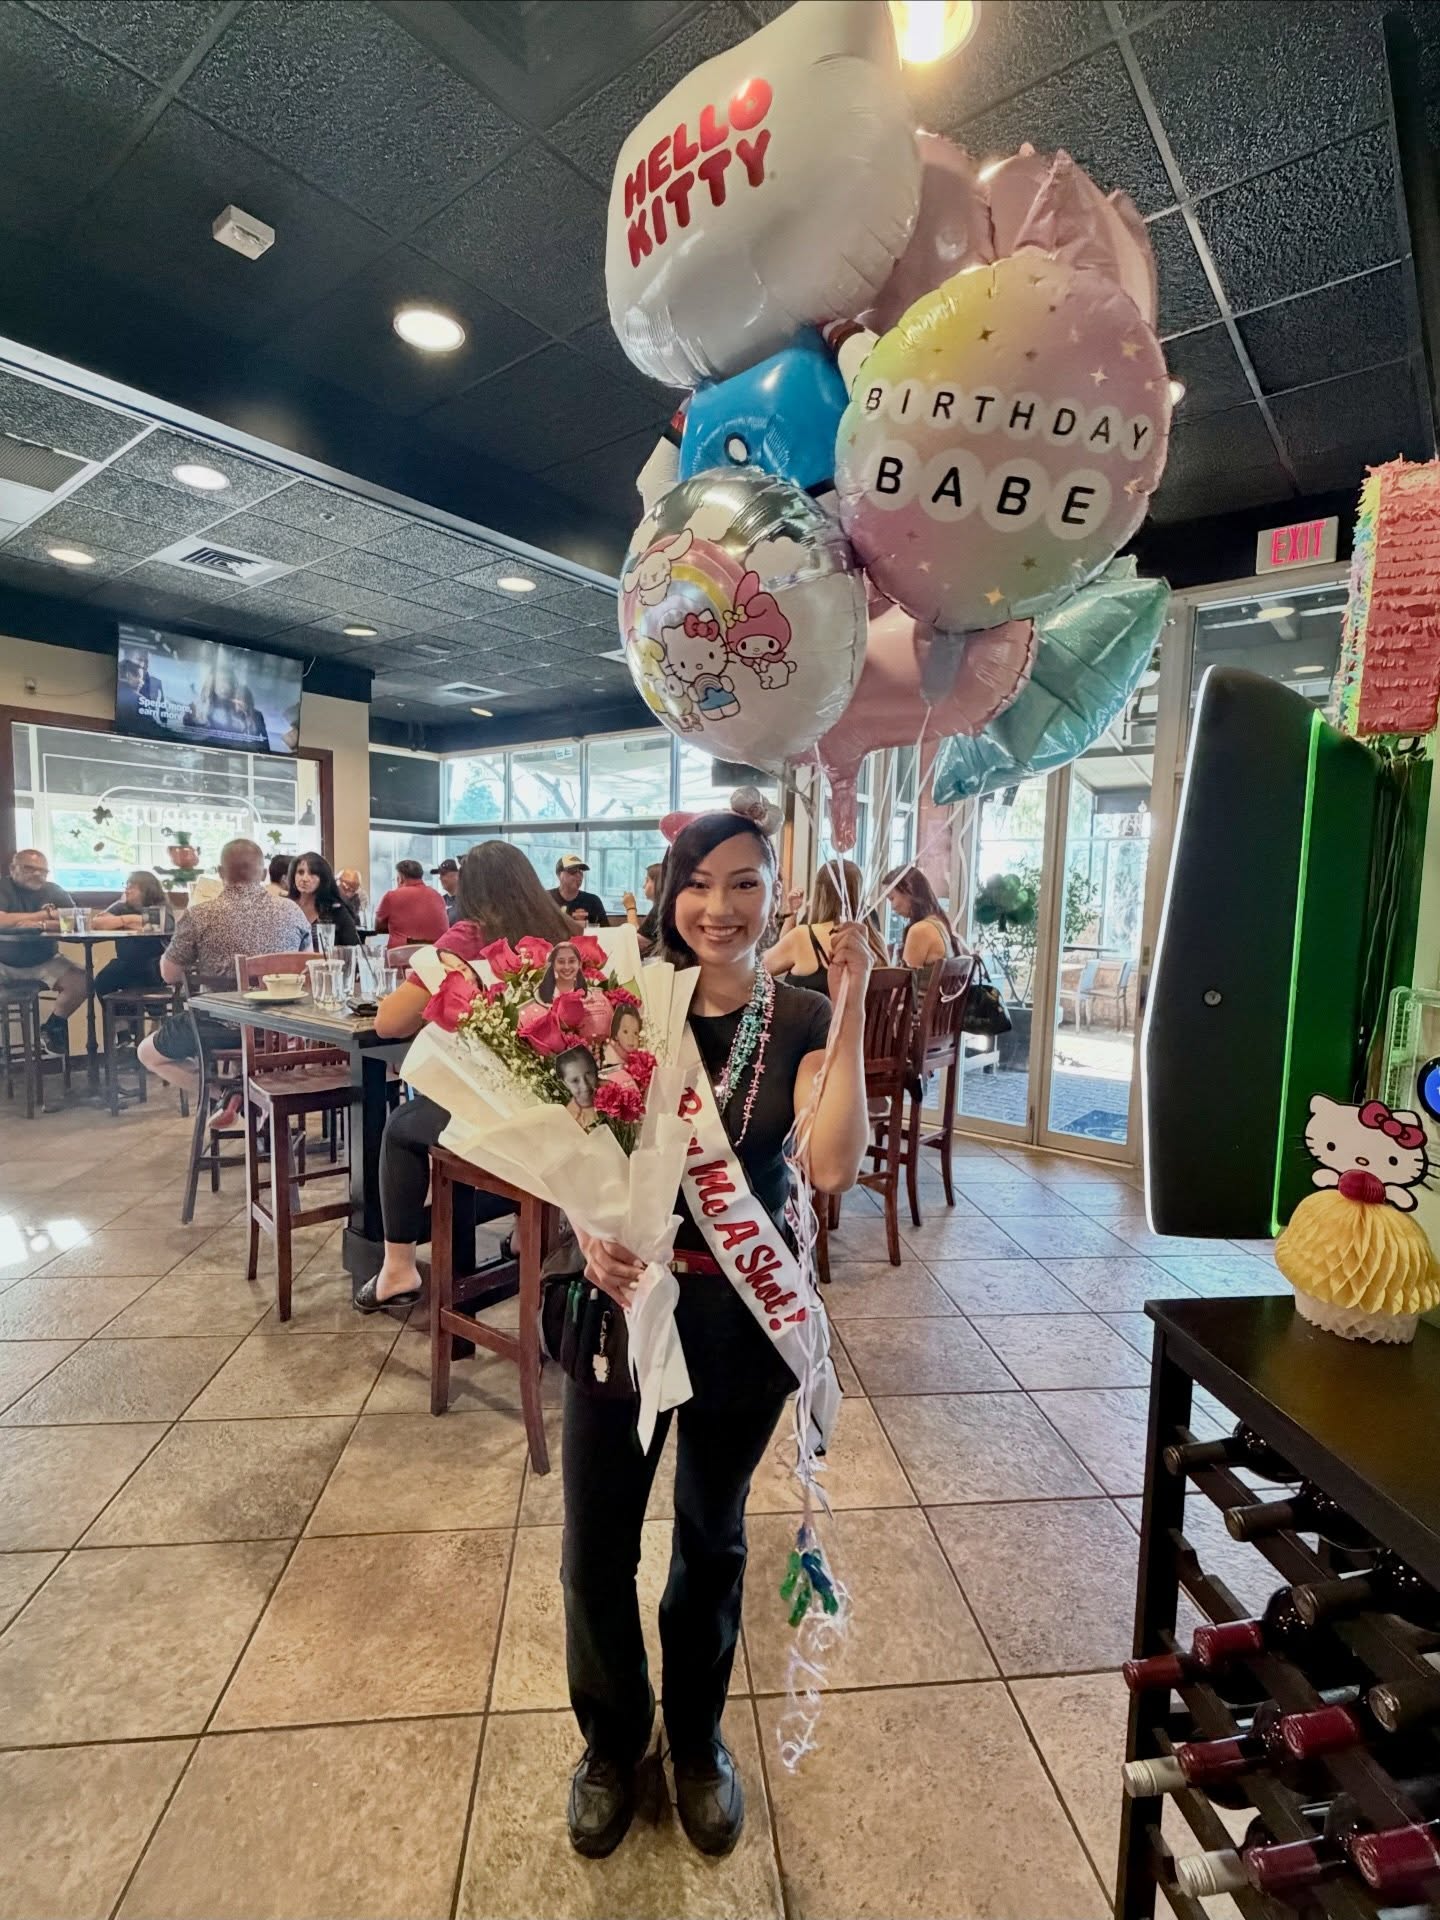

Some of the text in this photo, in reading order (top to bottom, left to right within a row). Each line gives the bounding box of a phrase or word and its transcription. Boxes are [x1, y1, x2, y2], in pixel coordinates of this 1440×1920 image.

[624, 77, 773, 218] HELLO
[627, 129, 771, 268] KITTY
[865, 387, 1148, 451] BIRTHDAY
[875, 456, 1096, 525] BABE
[1271, 520, 1327, 566] EXIT
[138, 696, 167, 710] Spend
[138, 707, 158, 717] earn
[688, 1160, 736, 1218] Me
[714, 1220, 760, 1251] A
[735, 1244, 806, 1331] Shot!
